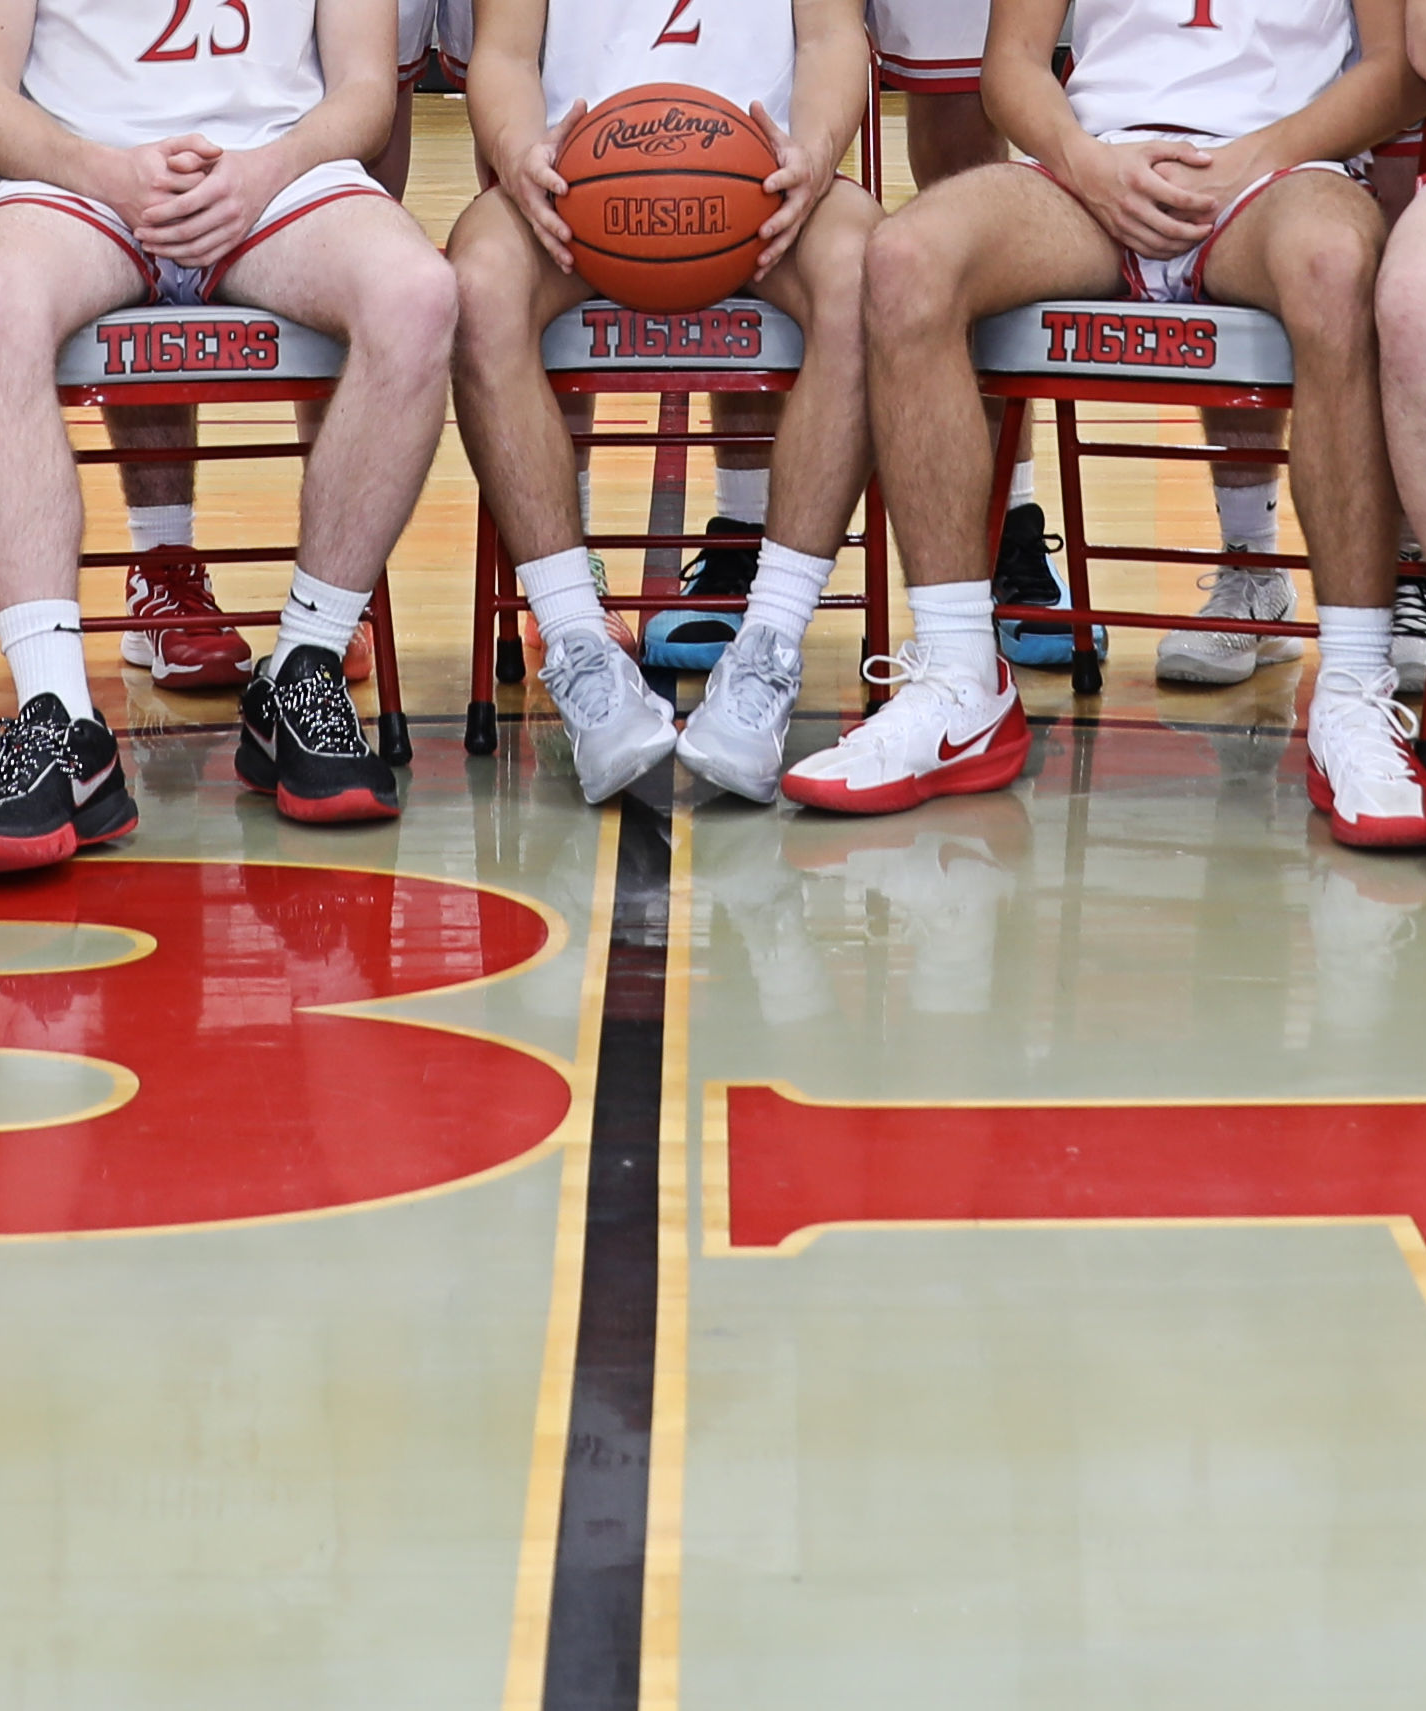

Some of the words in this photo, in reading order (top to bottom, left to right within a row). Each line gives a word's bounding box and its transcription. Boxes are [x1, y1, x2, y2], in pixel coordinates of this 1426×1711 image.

[593, 108, 734, 160] Rawlings
[604, 195, 726, 236] OHSAA
[97, 320, 280, 375] TIGERS
[581, 308, 762, 358] TIGERS
[1042, 310, 1217, 368] TIGERS
